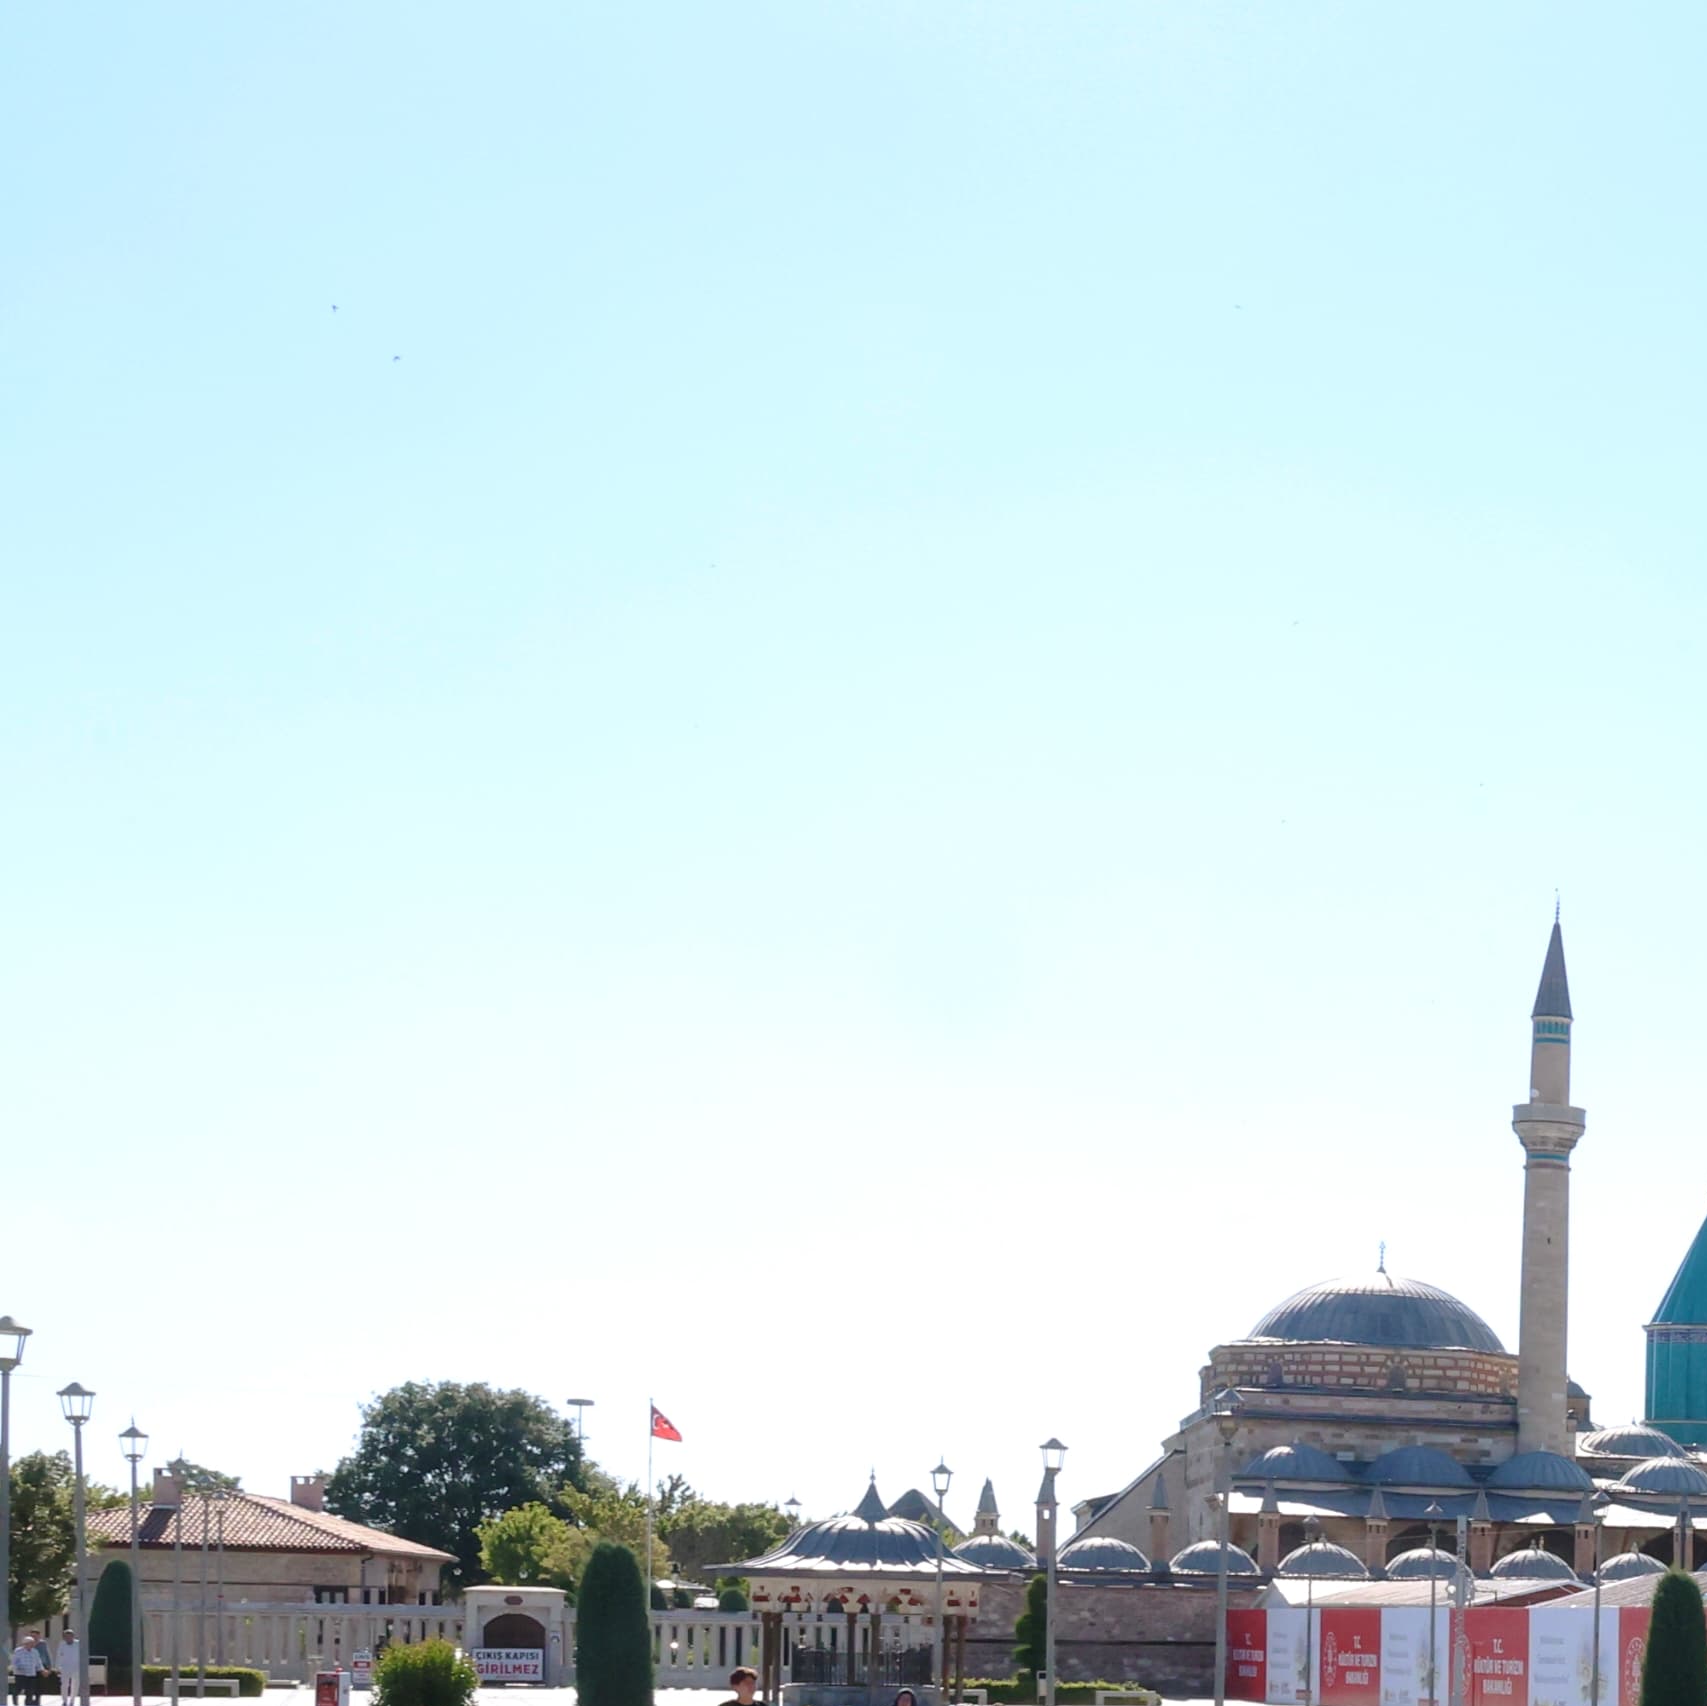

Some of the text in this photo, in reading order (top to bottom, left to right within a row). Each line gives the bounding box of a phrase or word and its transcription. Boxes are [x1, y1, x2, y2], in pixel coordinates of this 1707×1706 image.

[476, 1650, 539, 1662] ÇIKIŞ KAPISI
[477, 1662, 539, 1675] GİRİLMEZ
